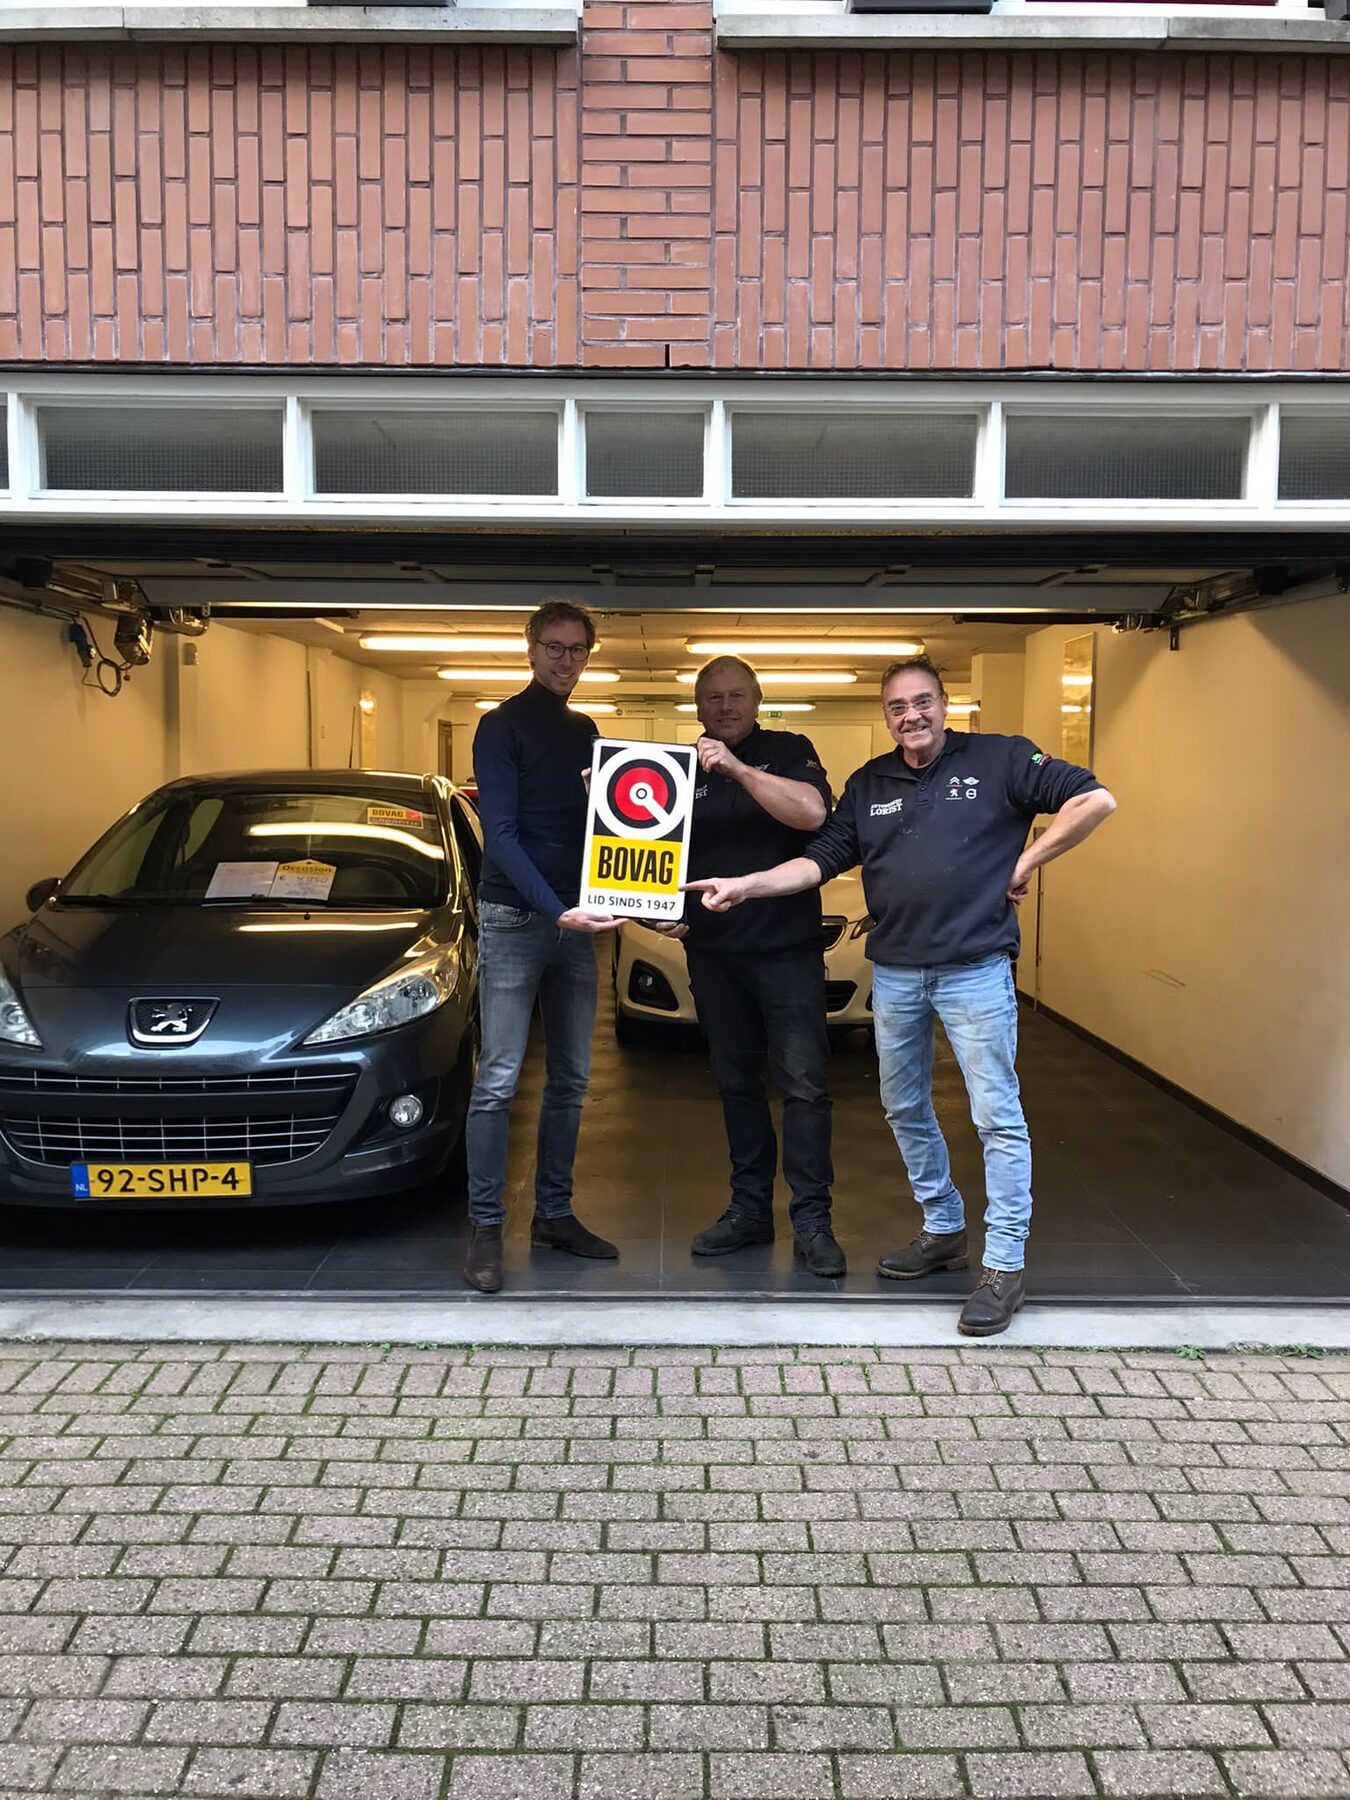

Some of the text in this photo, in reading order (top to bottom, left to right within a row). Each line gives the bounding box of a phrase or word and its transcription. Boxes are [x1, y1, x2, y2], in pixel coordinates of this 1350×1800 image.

[372, 808, 405, 818] BOVAG
[870, 802, 903, 816] LORIST
[282, 864, 332, 873] Occasion
[598, 845, 674, 885] BOVAG
[588, 894, 676, 911] LID SINDS 1947
[97, 1167, 239, 1193] 92-SHP-4
[75, 1183, 88, 1192] NL
